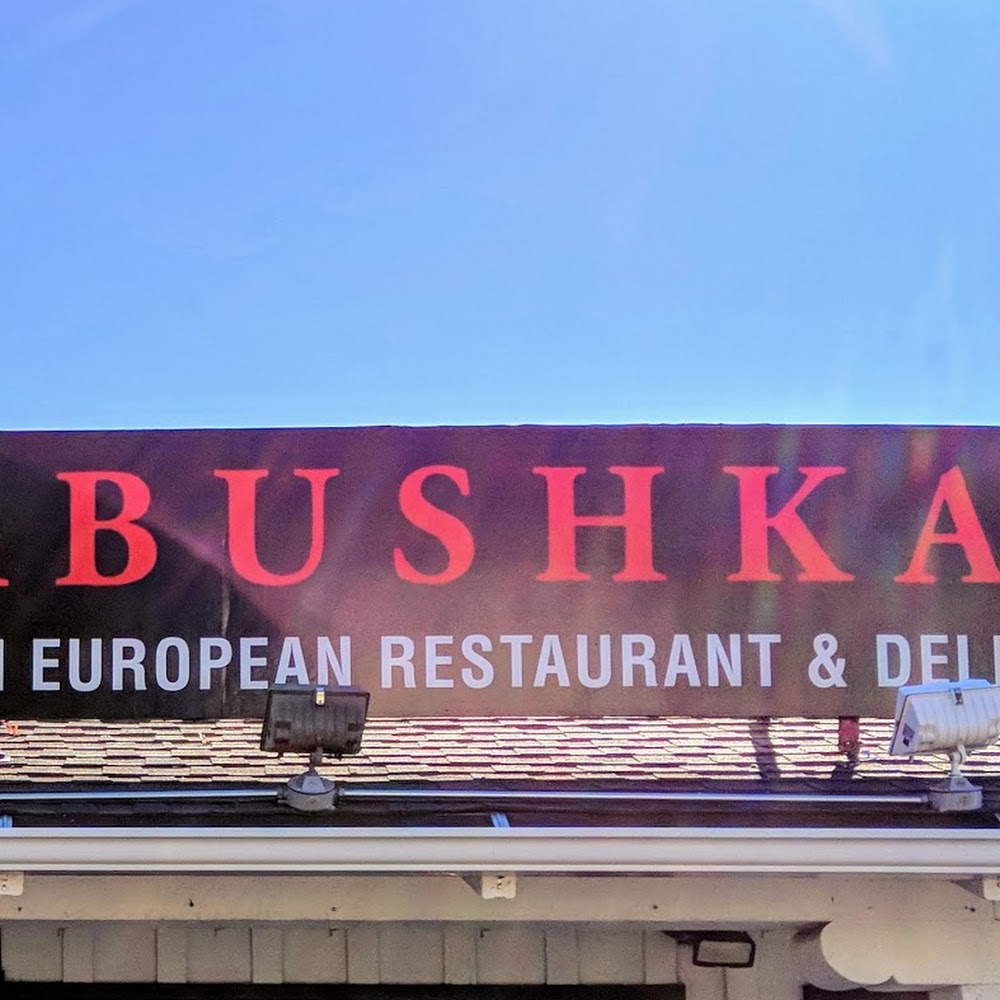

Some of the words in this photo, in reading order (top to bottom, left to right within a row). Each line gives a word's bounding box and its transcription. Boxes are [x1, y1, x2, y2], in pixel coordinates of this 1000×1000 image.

[32, 636, 352, 692] EUROPEAN
[380, 633, 781, 690] RESTAURANT
[807, 633, 847, 689] &
